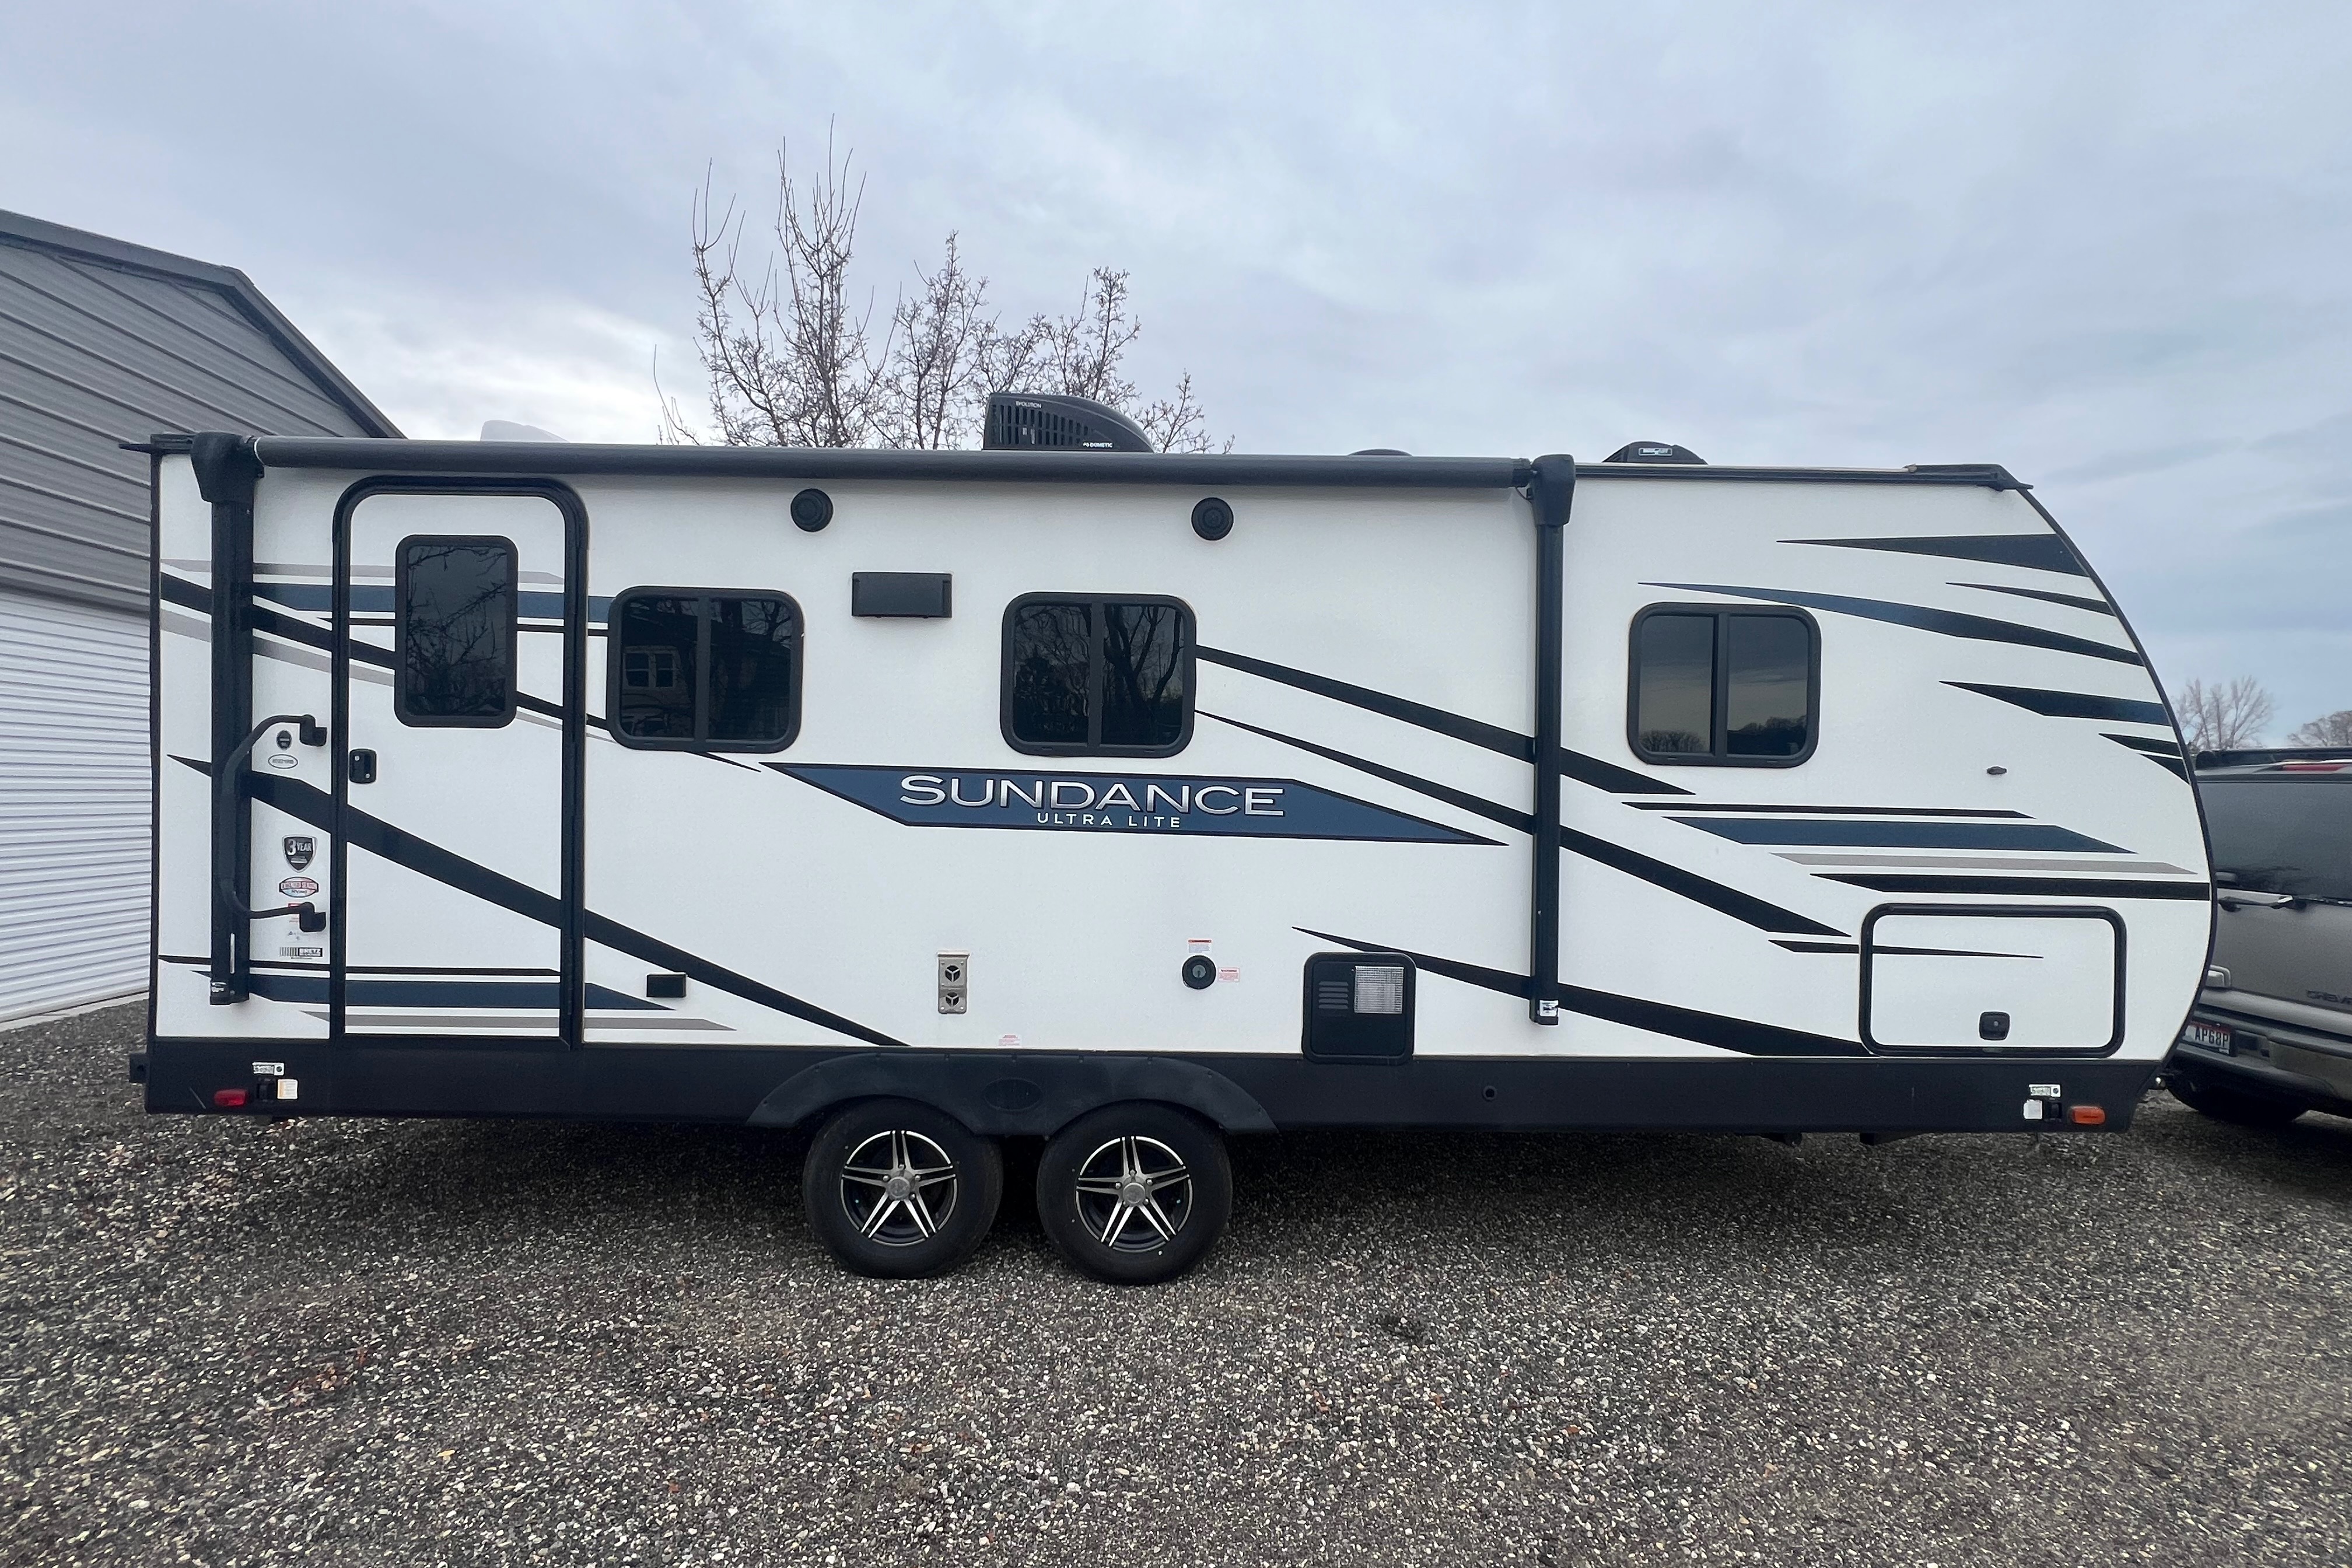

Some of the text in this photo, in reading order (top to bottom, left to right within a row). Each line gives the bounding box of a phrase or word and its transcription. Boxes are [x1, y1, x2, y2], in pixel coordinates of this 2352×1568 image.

[899, 774, 1284, 816] SUNDANCE
[1037, 813, 1181, 827] ULTRA LITE
[286, 838, 312, 856] 3 YEAR
